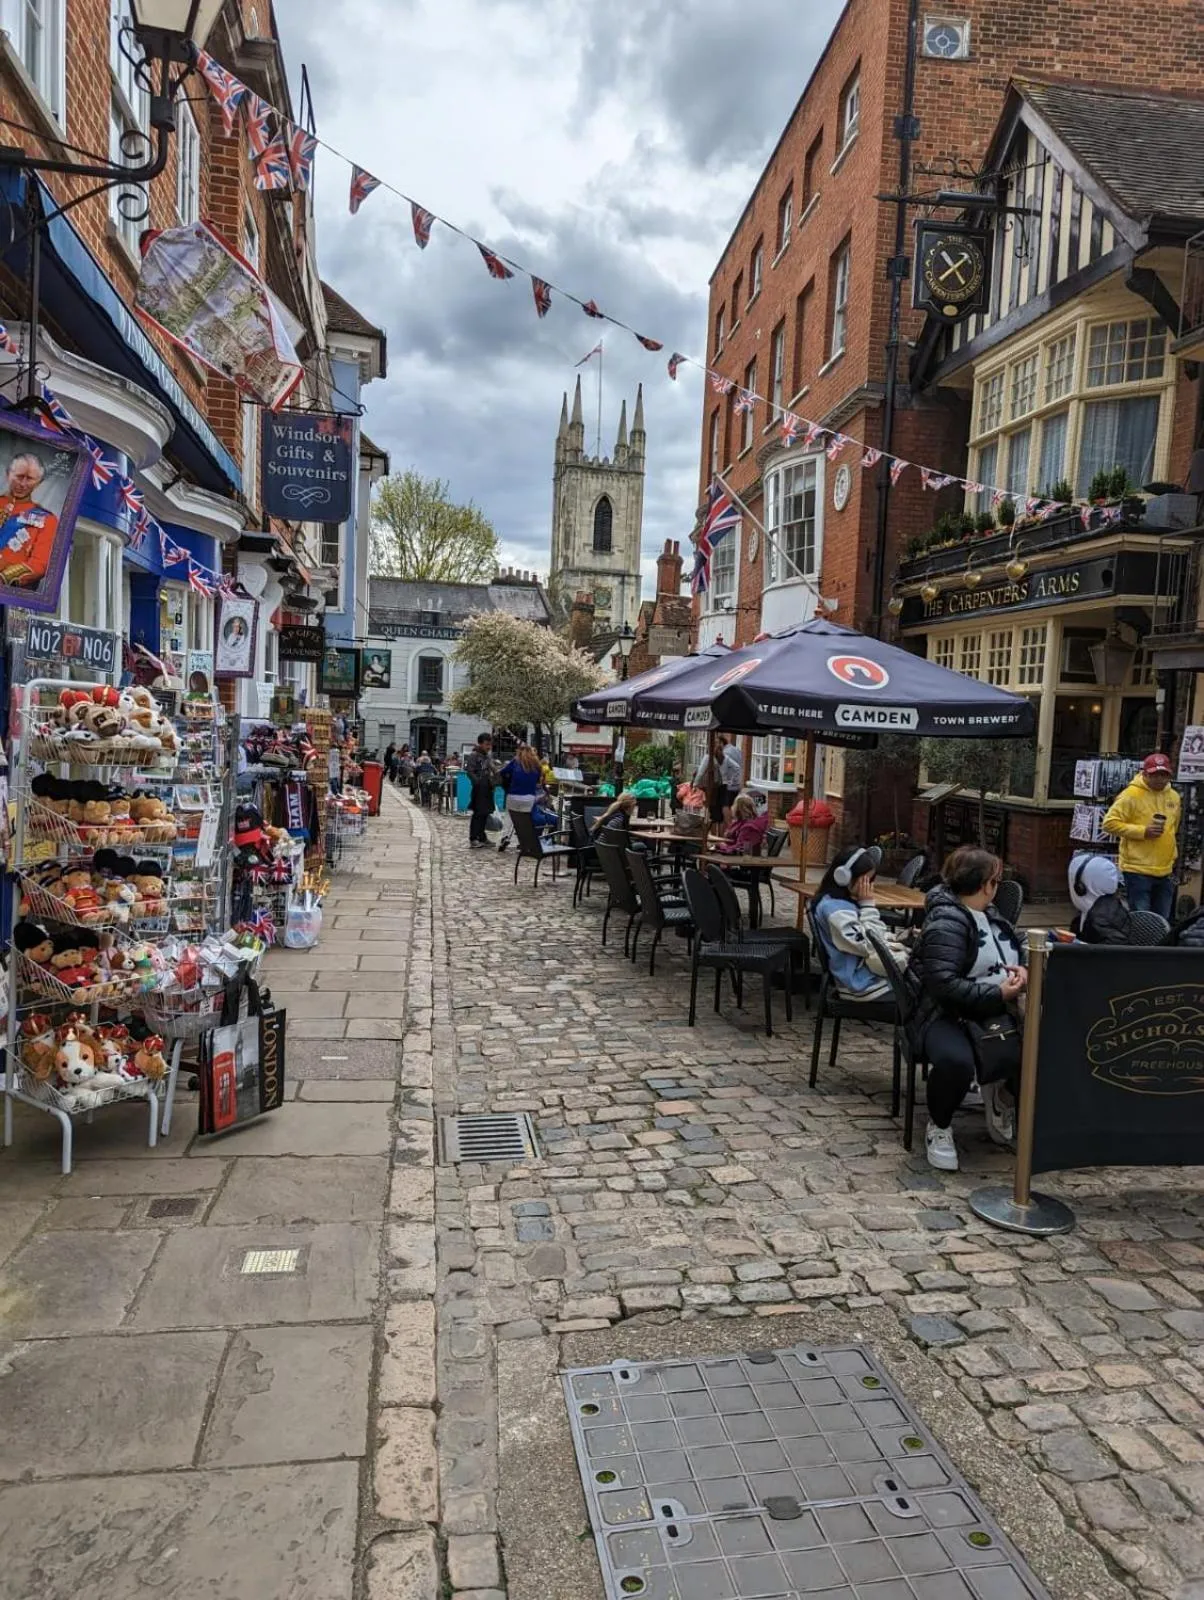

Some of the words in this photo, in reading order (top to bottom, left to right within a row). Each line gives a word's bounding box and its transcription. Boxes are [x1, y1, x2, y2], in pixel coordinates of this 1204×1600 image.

[272, 425, 340, 444] Windsor
[276, 445, 314, 460] Gifts
[323, 449, 335, 463] &
[268, 461, 347, 481] Souvenirs
[923, 598, 943, 617] THE
[949, 583, 1029, 613] CARPENTERS
[1035, 572, 1080, 598] ARMS
[381, 626, 418, 637] QUEEN
[420, 628, 467, 640] CHARLO
[771, 705, 796, 717] BEER
[798, 707, 824, 719] HERE
[841, 709, 911, 725] CAMDEN
[932, 716, 965, 725] TOWN
[968, 715, 1021, 725] BREWERY
[263, 1017, 278, 1110] LONDON
